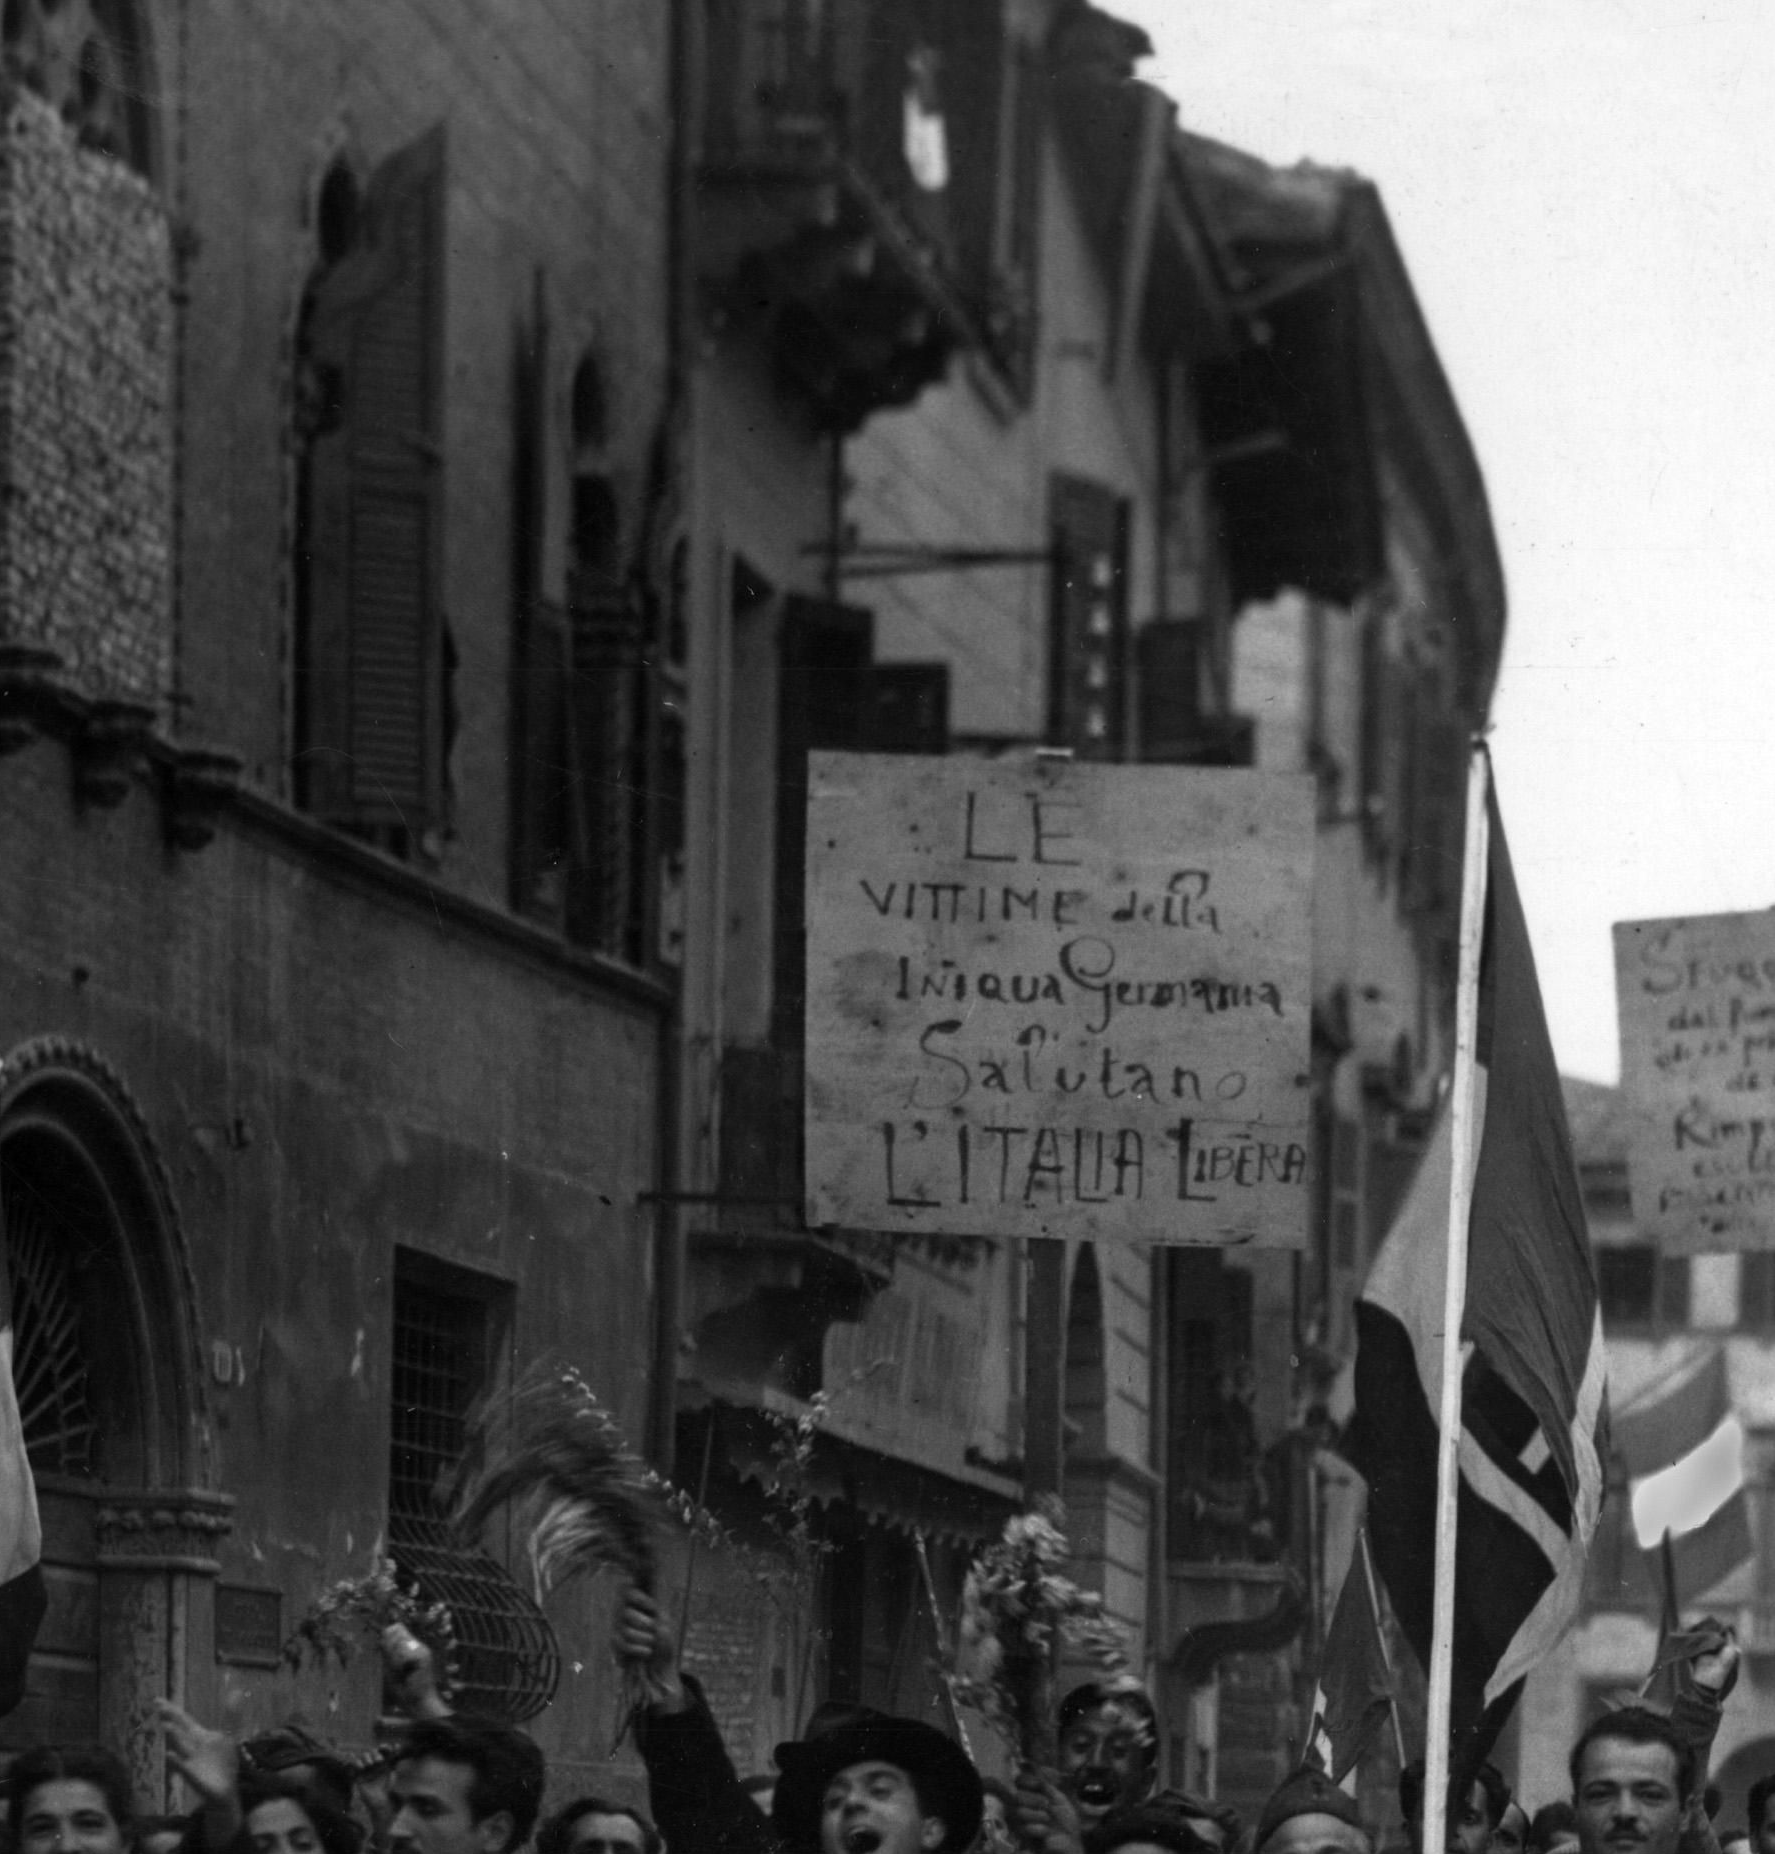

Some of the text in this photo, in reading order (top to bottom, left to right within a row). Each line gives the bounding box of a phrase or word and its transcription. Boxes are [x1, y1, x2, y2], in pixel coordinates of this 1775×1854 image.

[964, 790, 1083, 866] LE
[860, 869, 1222, 933] VITTIME della
[1059, 935, 1285, 1034] Germania
[903, 1018, 1247, 1111] Salutano
[883, 1121, 1144, 1208] L'ITALIA
